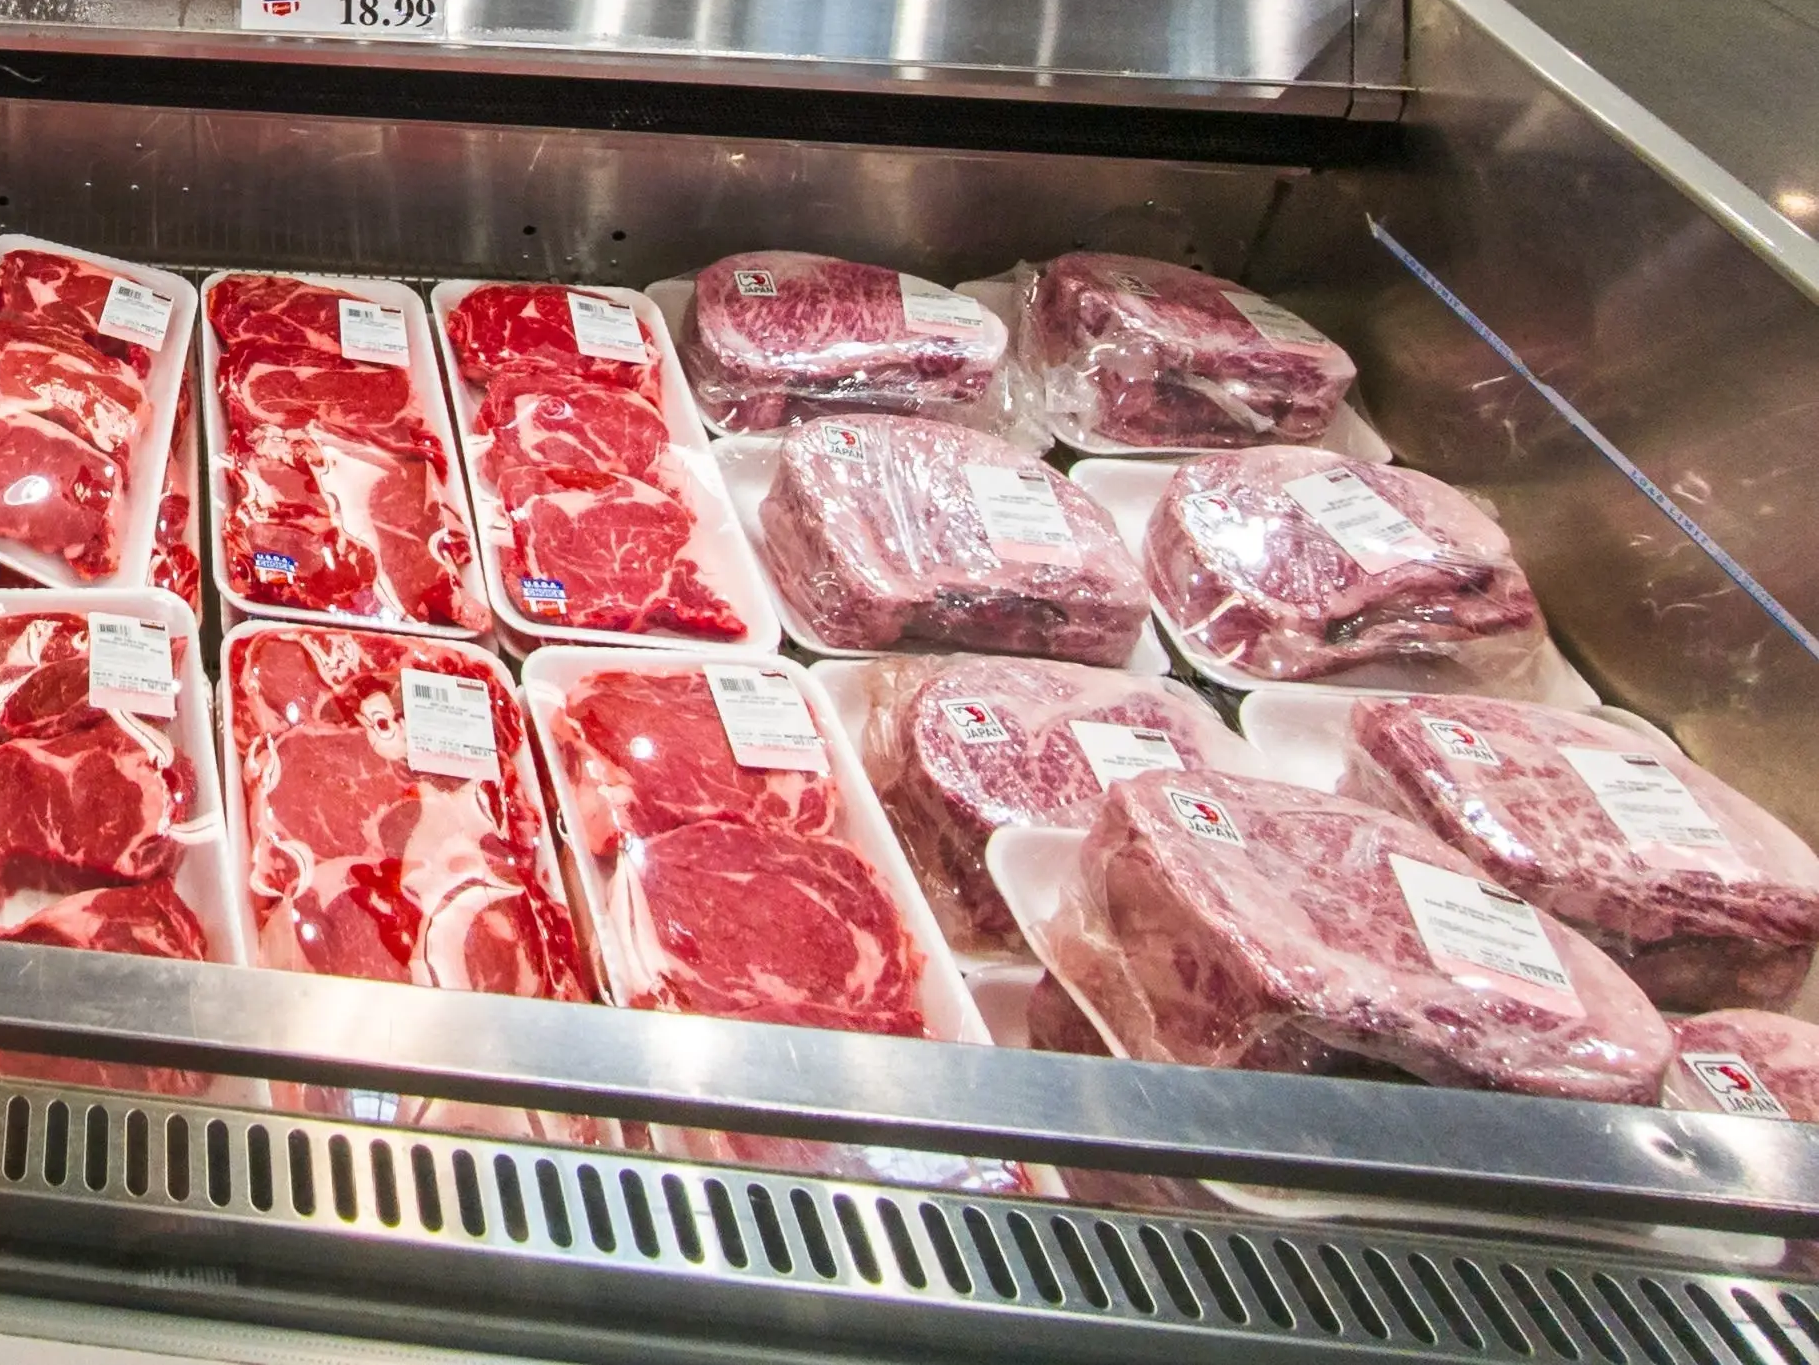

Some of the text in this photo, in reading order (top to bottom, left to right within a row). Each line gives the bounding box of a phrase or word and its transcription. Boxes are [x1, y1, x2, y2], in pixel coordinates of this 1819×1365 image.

[742, 287, 775, 295] JAPAN
[829, 445, 864, 460] JAPAN
[1631, 469, 1709, 544] LOAD LIMIT
[522, 579, 561, 589] U.S.D.A.
[964, 727, 1005, 739] JAPAN
[1452, 745, 1494, 761] JAPAN
[1189, 822, 1239, 842] JAPAN
[1726, 1096, 1781, 1114] JAPAN
